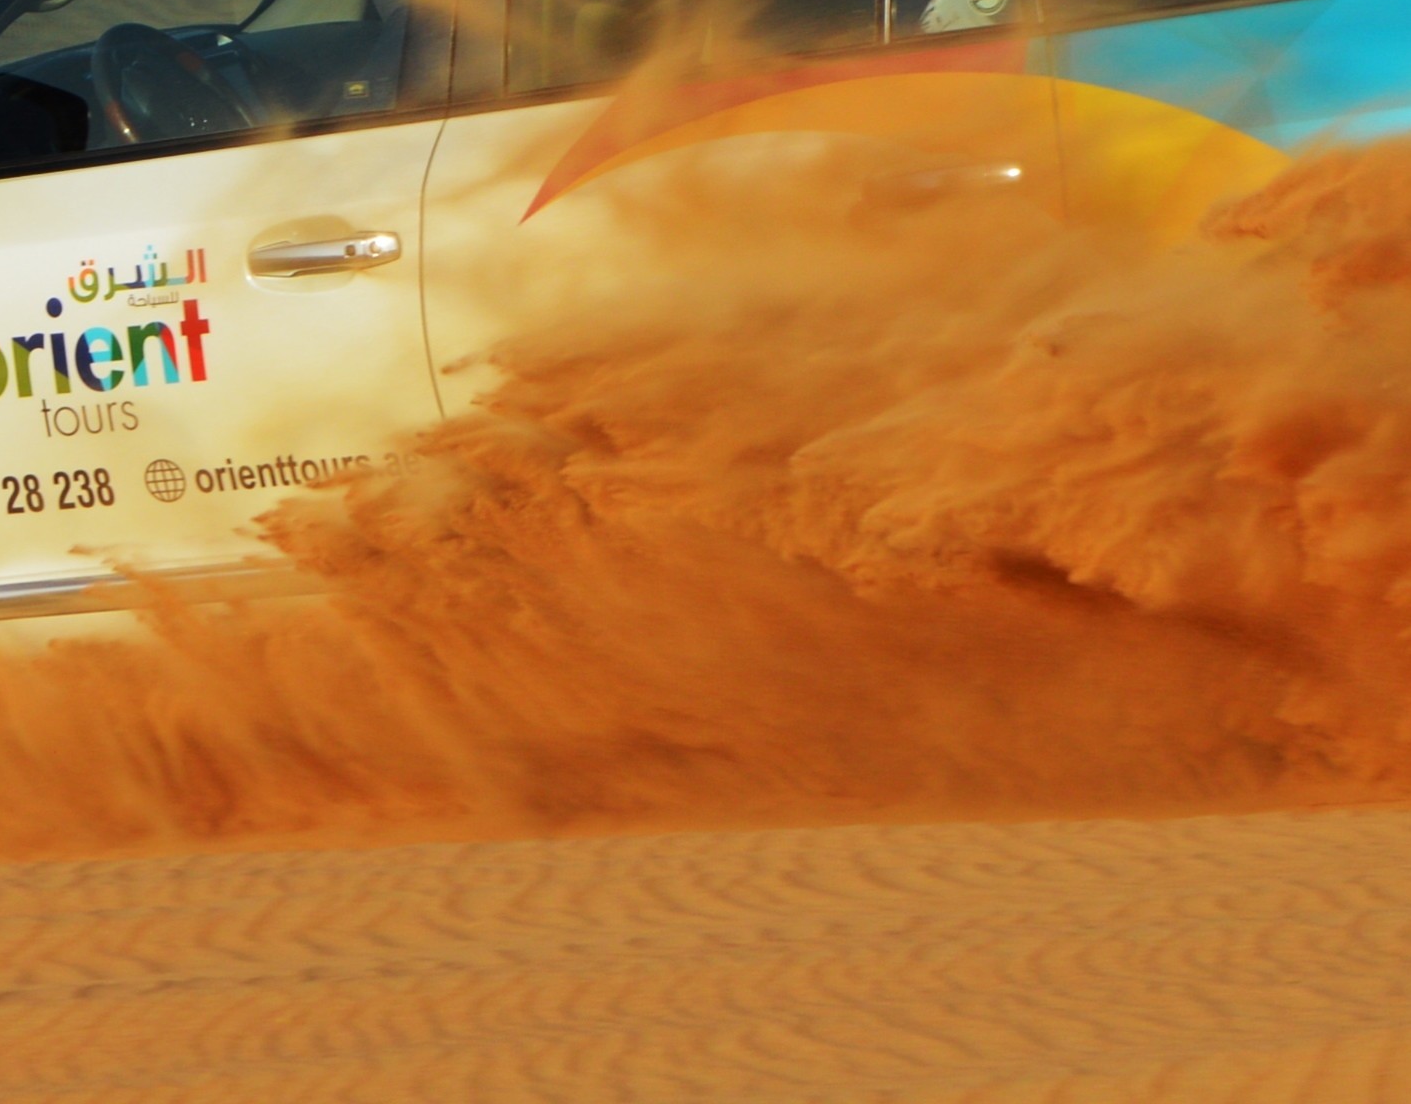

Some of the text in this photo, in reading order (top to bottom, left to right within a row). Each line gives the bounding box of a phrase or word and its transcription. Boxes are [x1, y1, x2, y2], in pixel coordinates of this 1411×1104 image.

[67, 244, 208, 304] الشرق
[126, 291, 180, 308] للسياحة
[40, 398, 140, 438] tours
[1, 474, 45, 515] 28
[52, 468, 115, 511] 238
